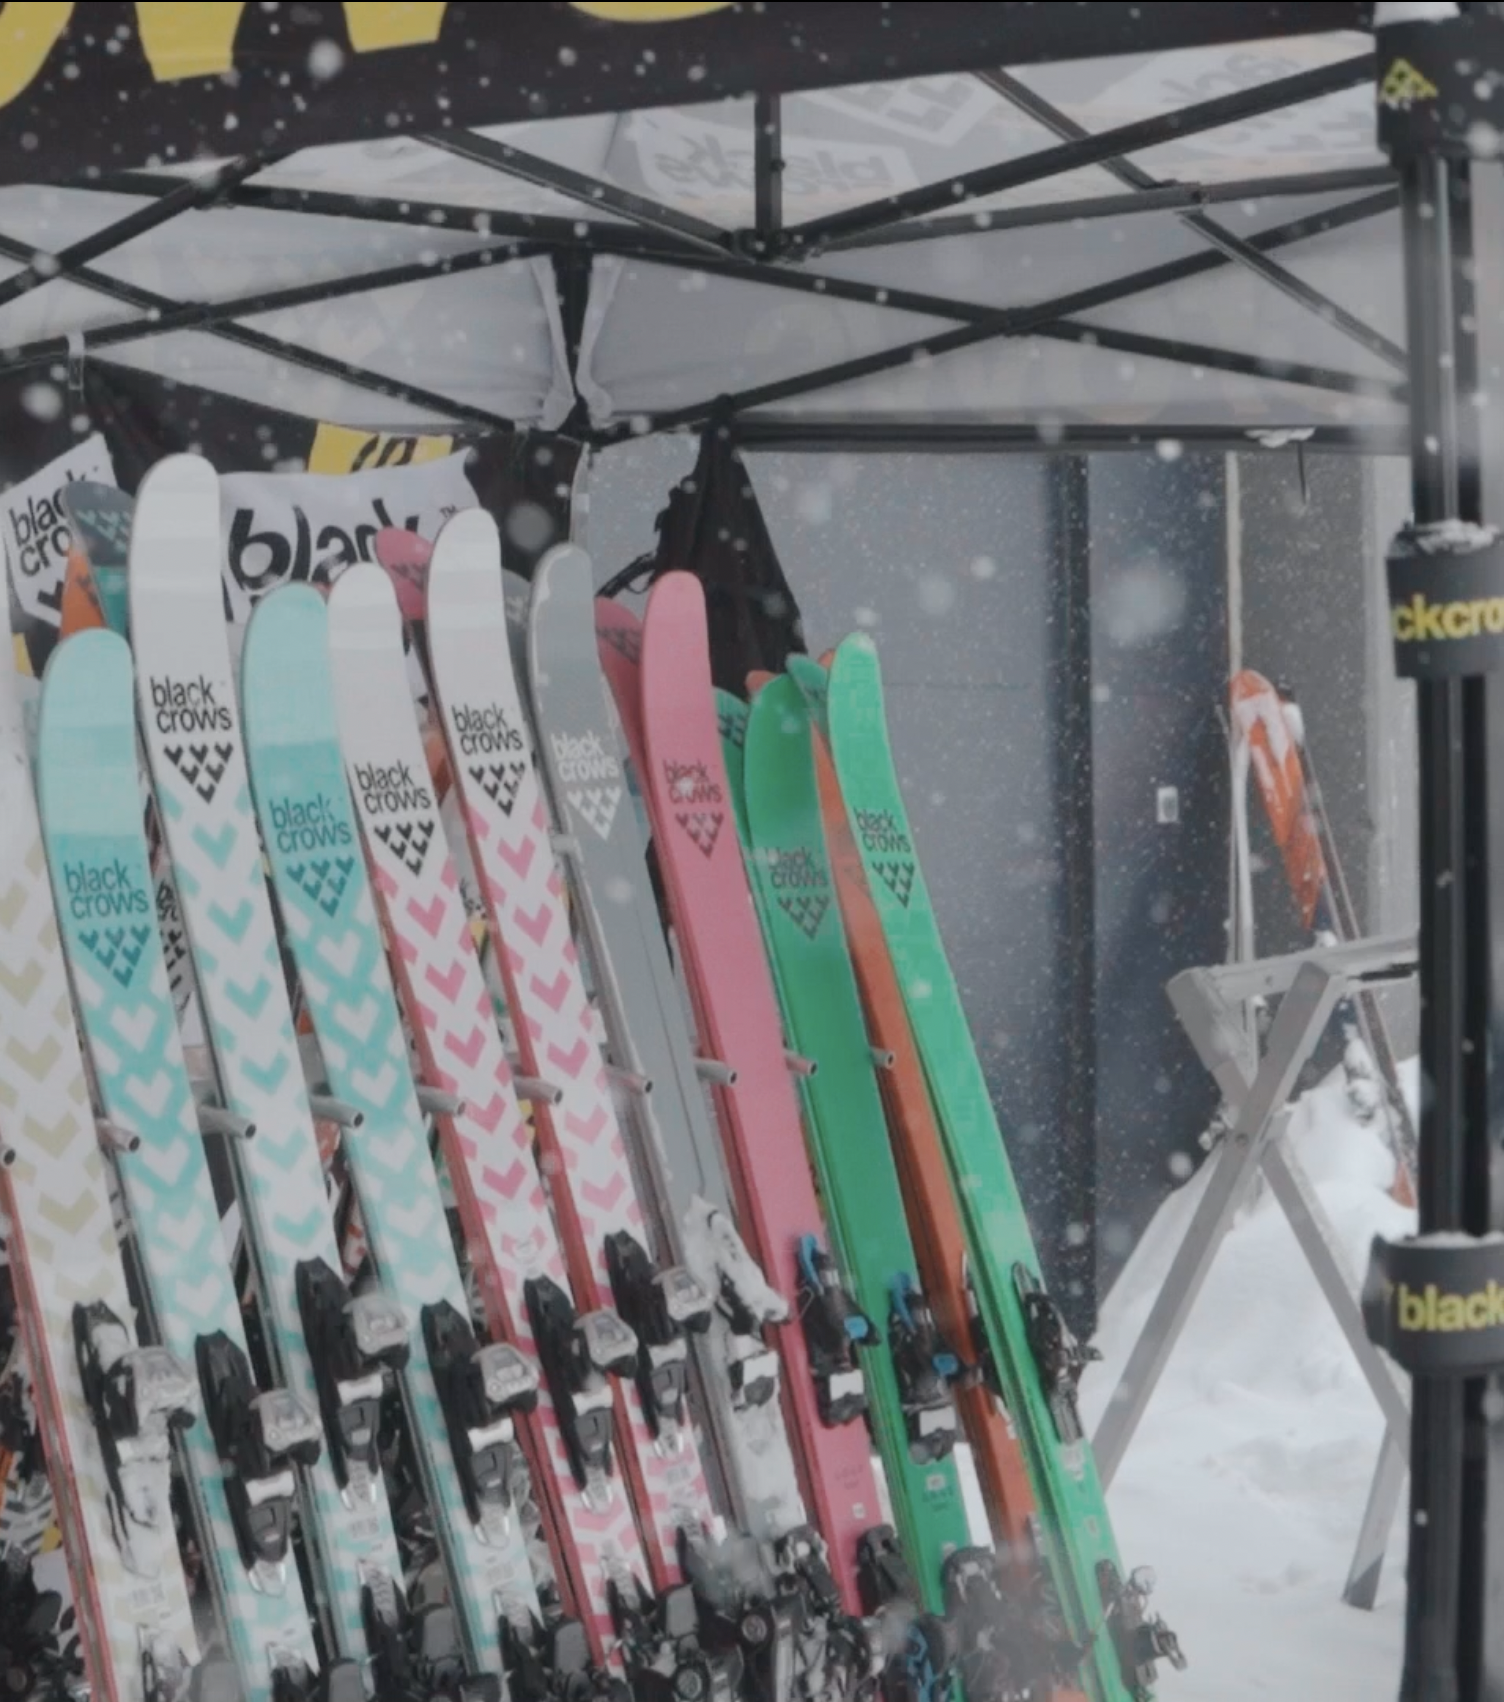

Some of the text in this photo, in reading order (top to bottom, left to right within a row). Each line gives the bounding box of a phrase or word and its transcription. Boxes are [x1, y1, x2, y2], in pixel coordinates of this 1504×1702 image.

[19, 525, 74, 578] cro
[229, 498, 420, 591] bla
[150, 674, 215, 708] black
[156, 706, 233, 734] crows
[451, 702, 509, 733] black
[459, 728, 524, 757] crows
[550, 729, 607, 761] black
[354, 759, 415, 791] black
[558, 755, 621, 783] crows
[363, 787, 432, 816] crows
[668, 782, 723, 805] cows
[269, 794, 336, 830] black
[276, 821, 353, 855] crows
[63, 857, 132, 893] black
[70, 888, 150, 920] crows
